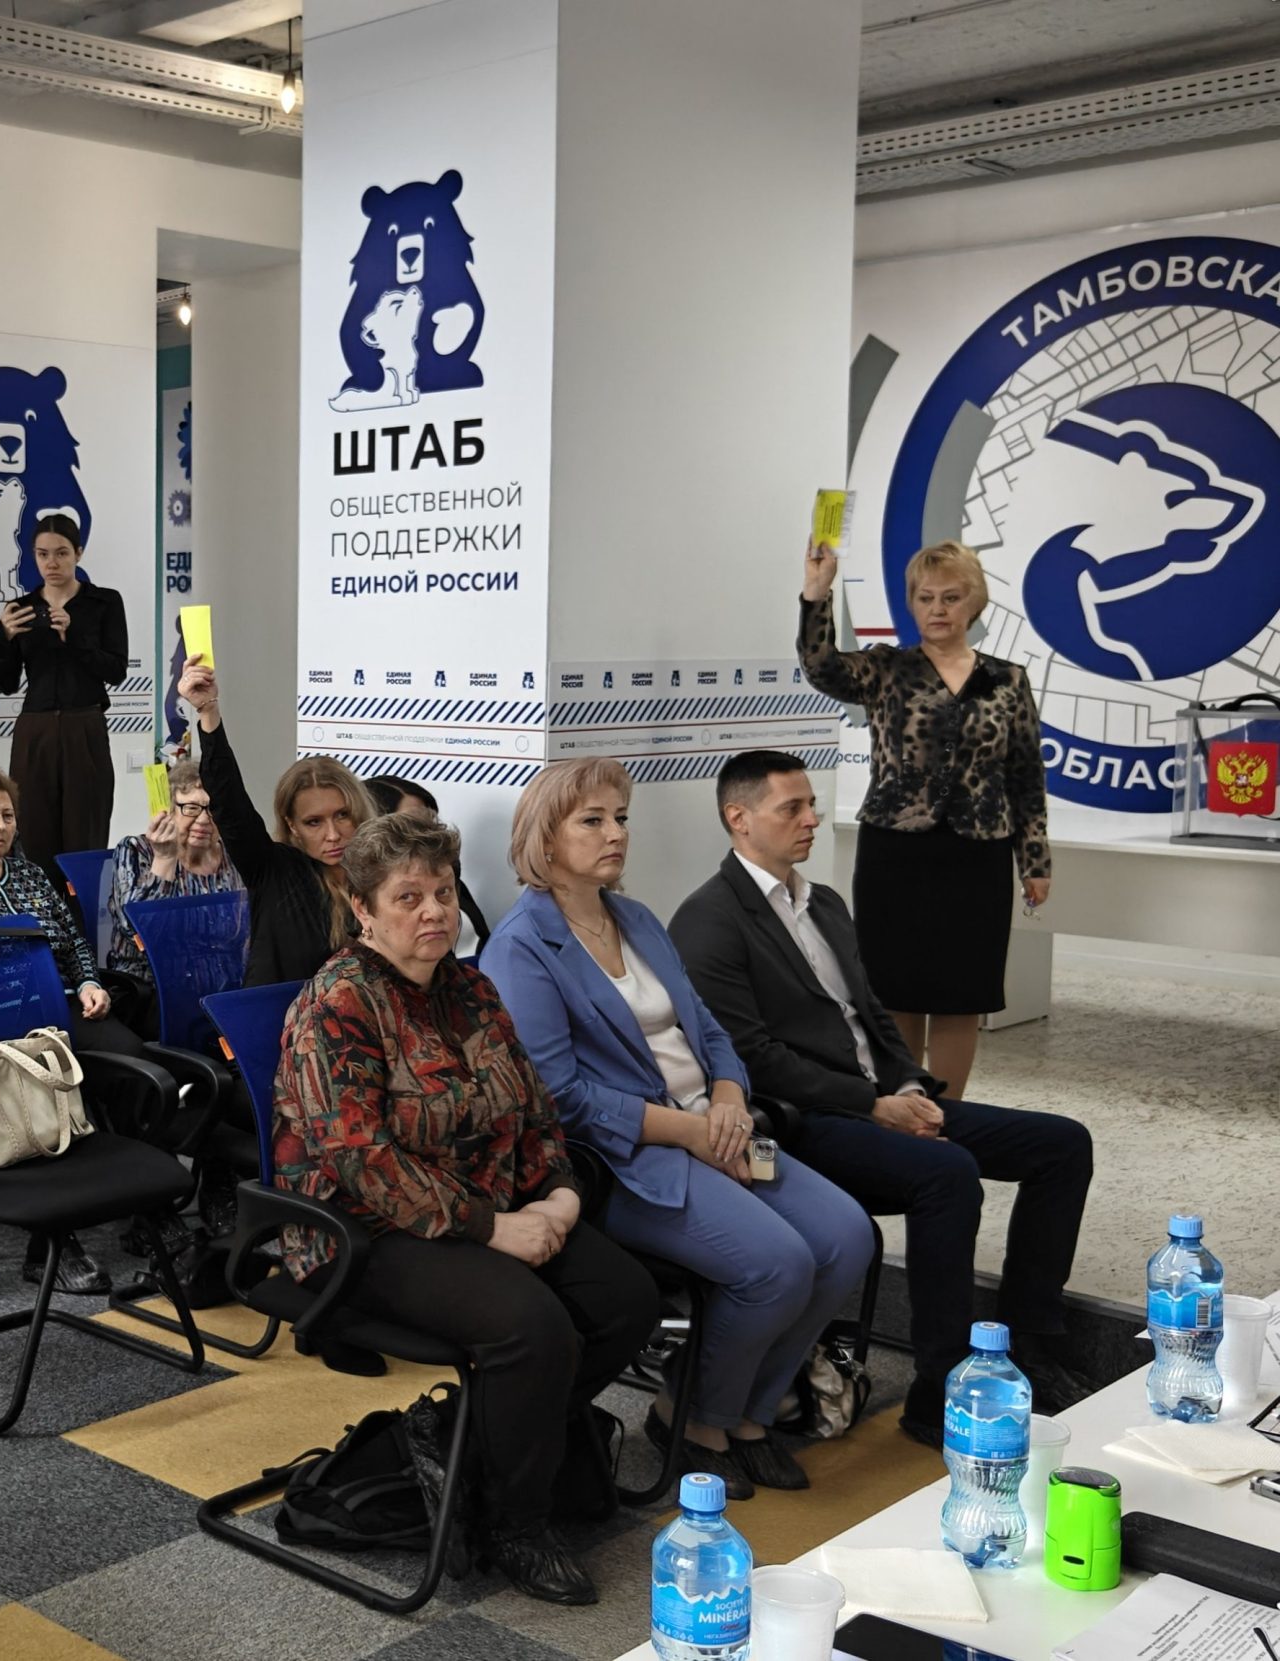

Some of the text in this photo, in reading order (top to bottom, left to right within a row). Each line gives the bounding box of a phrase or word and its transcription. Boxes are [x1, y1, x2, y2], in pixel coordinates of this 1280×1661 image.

[1001, 255, 1280, 348] ТАМБОВСКА
[333, 417, 485, 476] ШТАБ
[330, 481, 522, 518] ОБЩЕСТВЕННОЙ
[331, 523, 521, 560] ПОДДЕРЖКИ
[331, 569, 519, 598] ЕДИНОЙ РОССИИ
